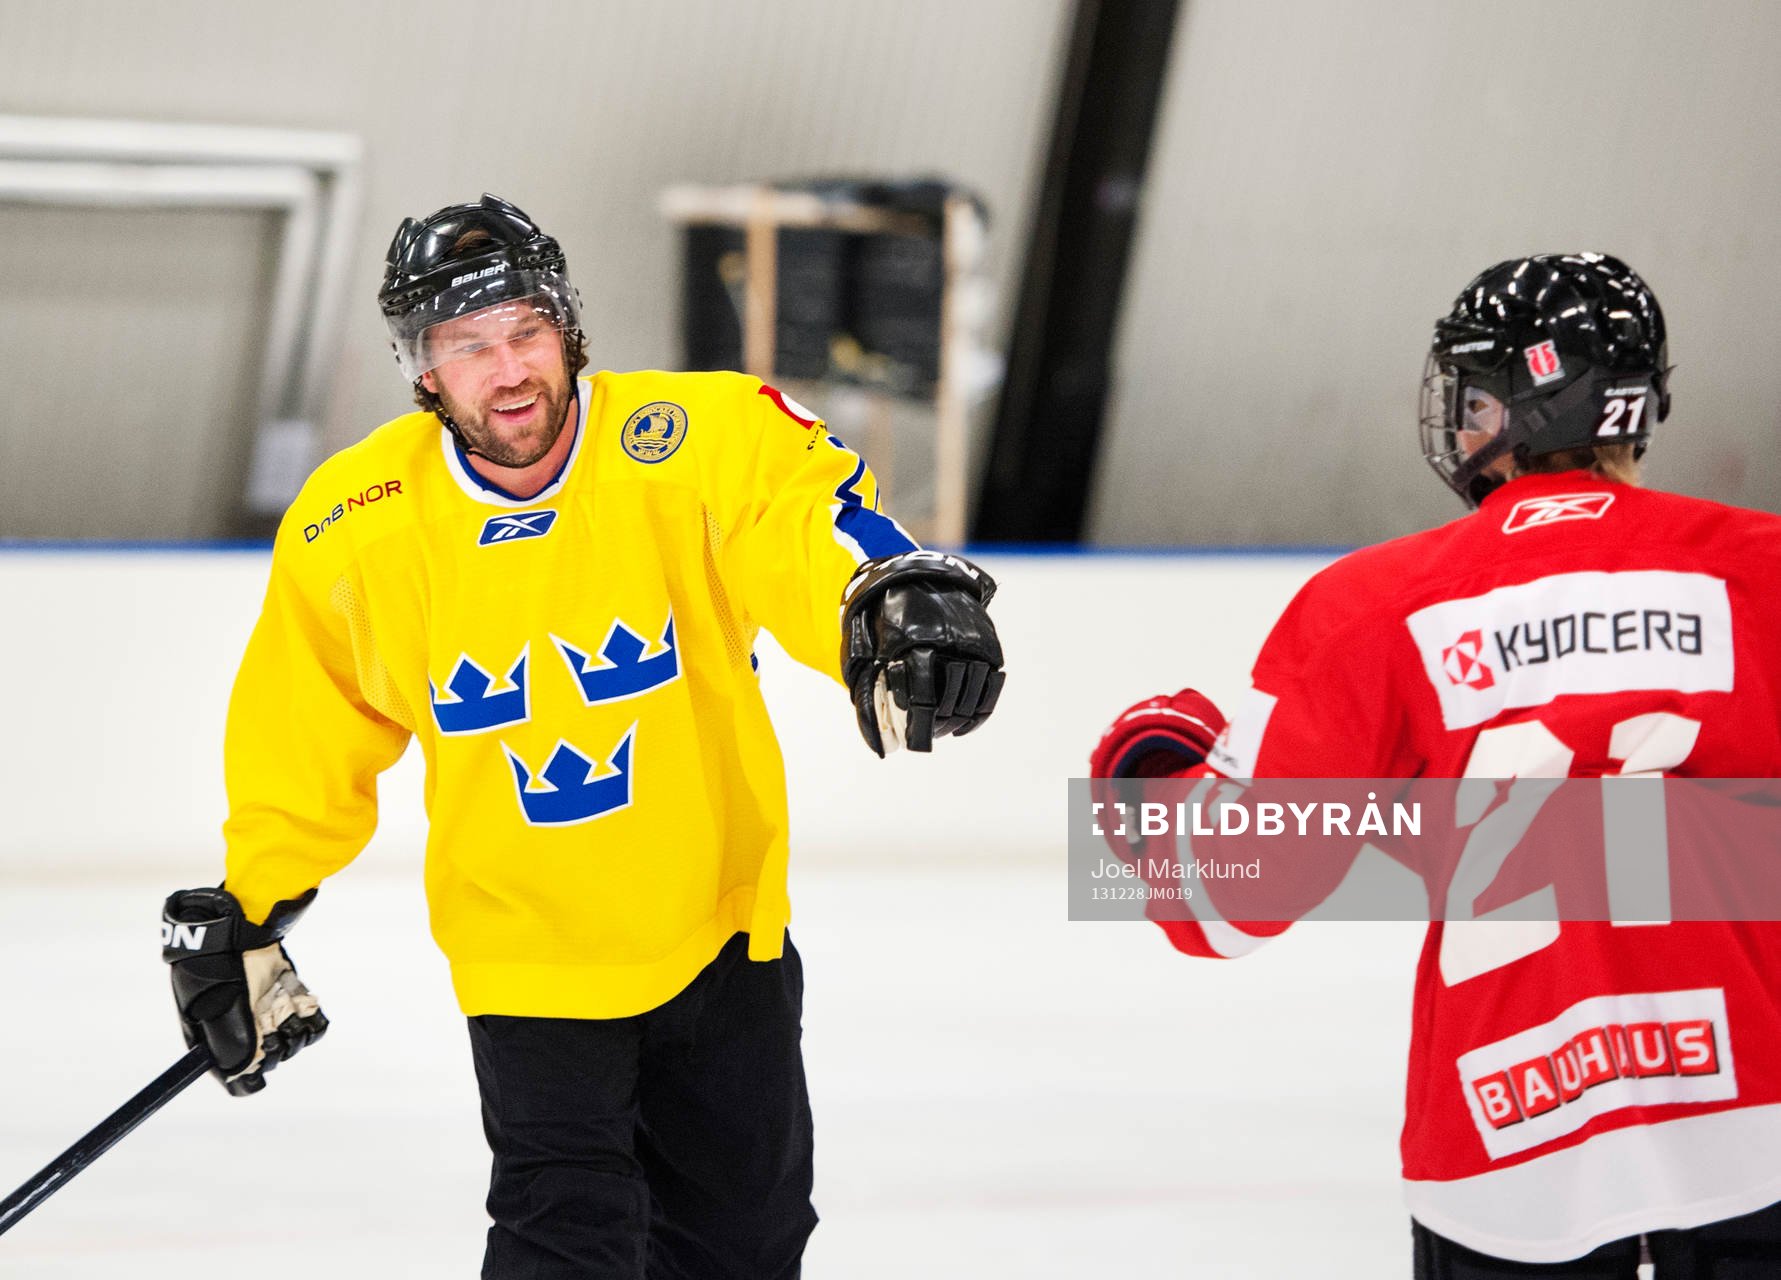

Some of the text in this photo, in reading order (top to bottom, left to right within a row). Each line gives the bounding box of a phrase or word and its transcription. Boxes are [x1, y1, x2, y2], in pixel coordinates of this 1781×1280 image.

[1597, 396, 1646, 437] 21
[346, 479, 403, 512] NOR
[1494, 609, 1702, 673] KYOCERA
[1439, 712, 1701, 988] 21
